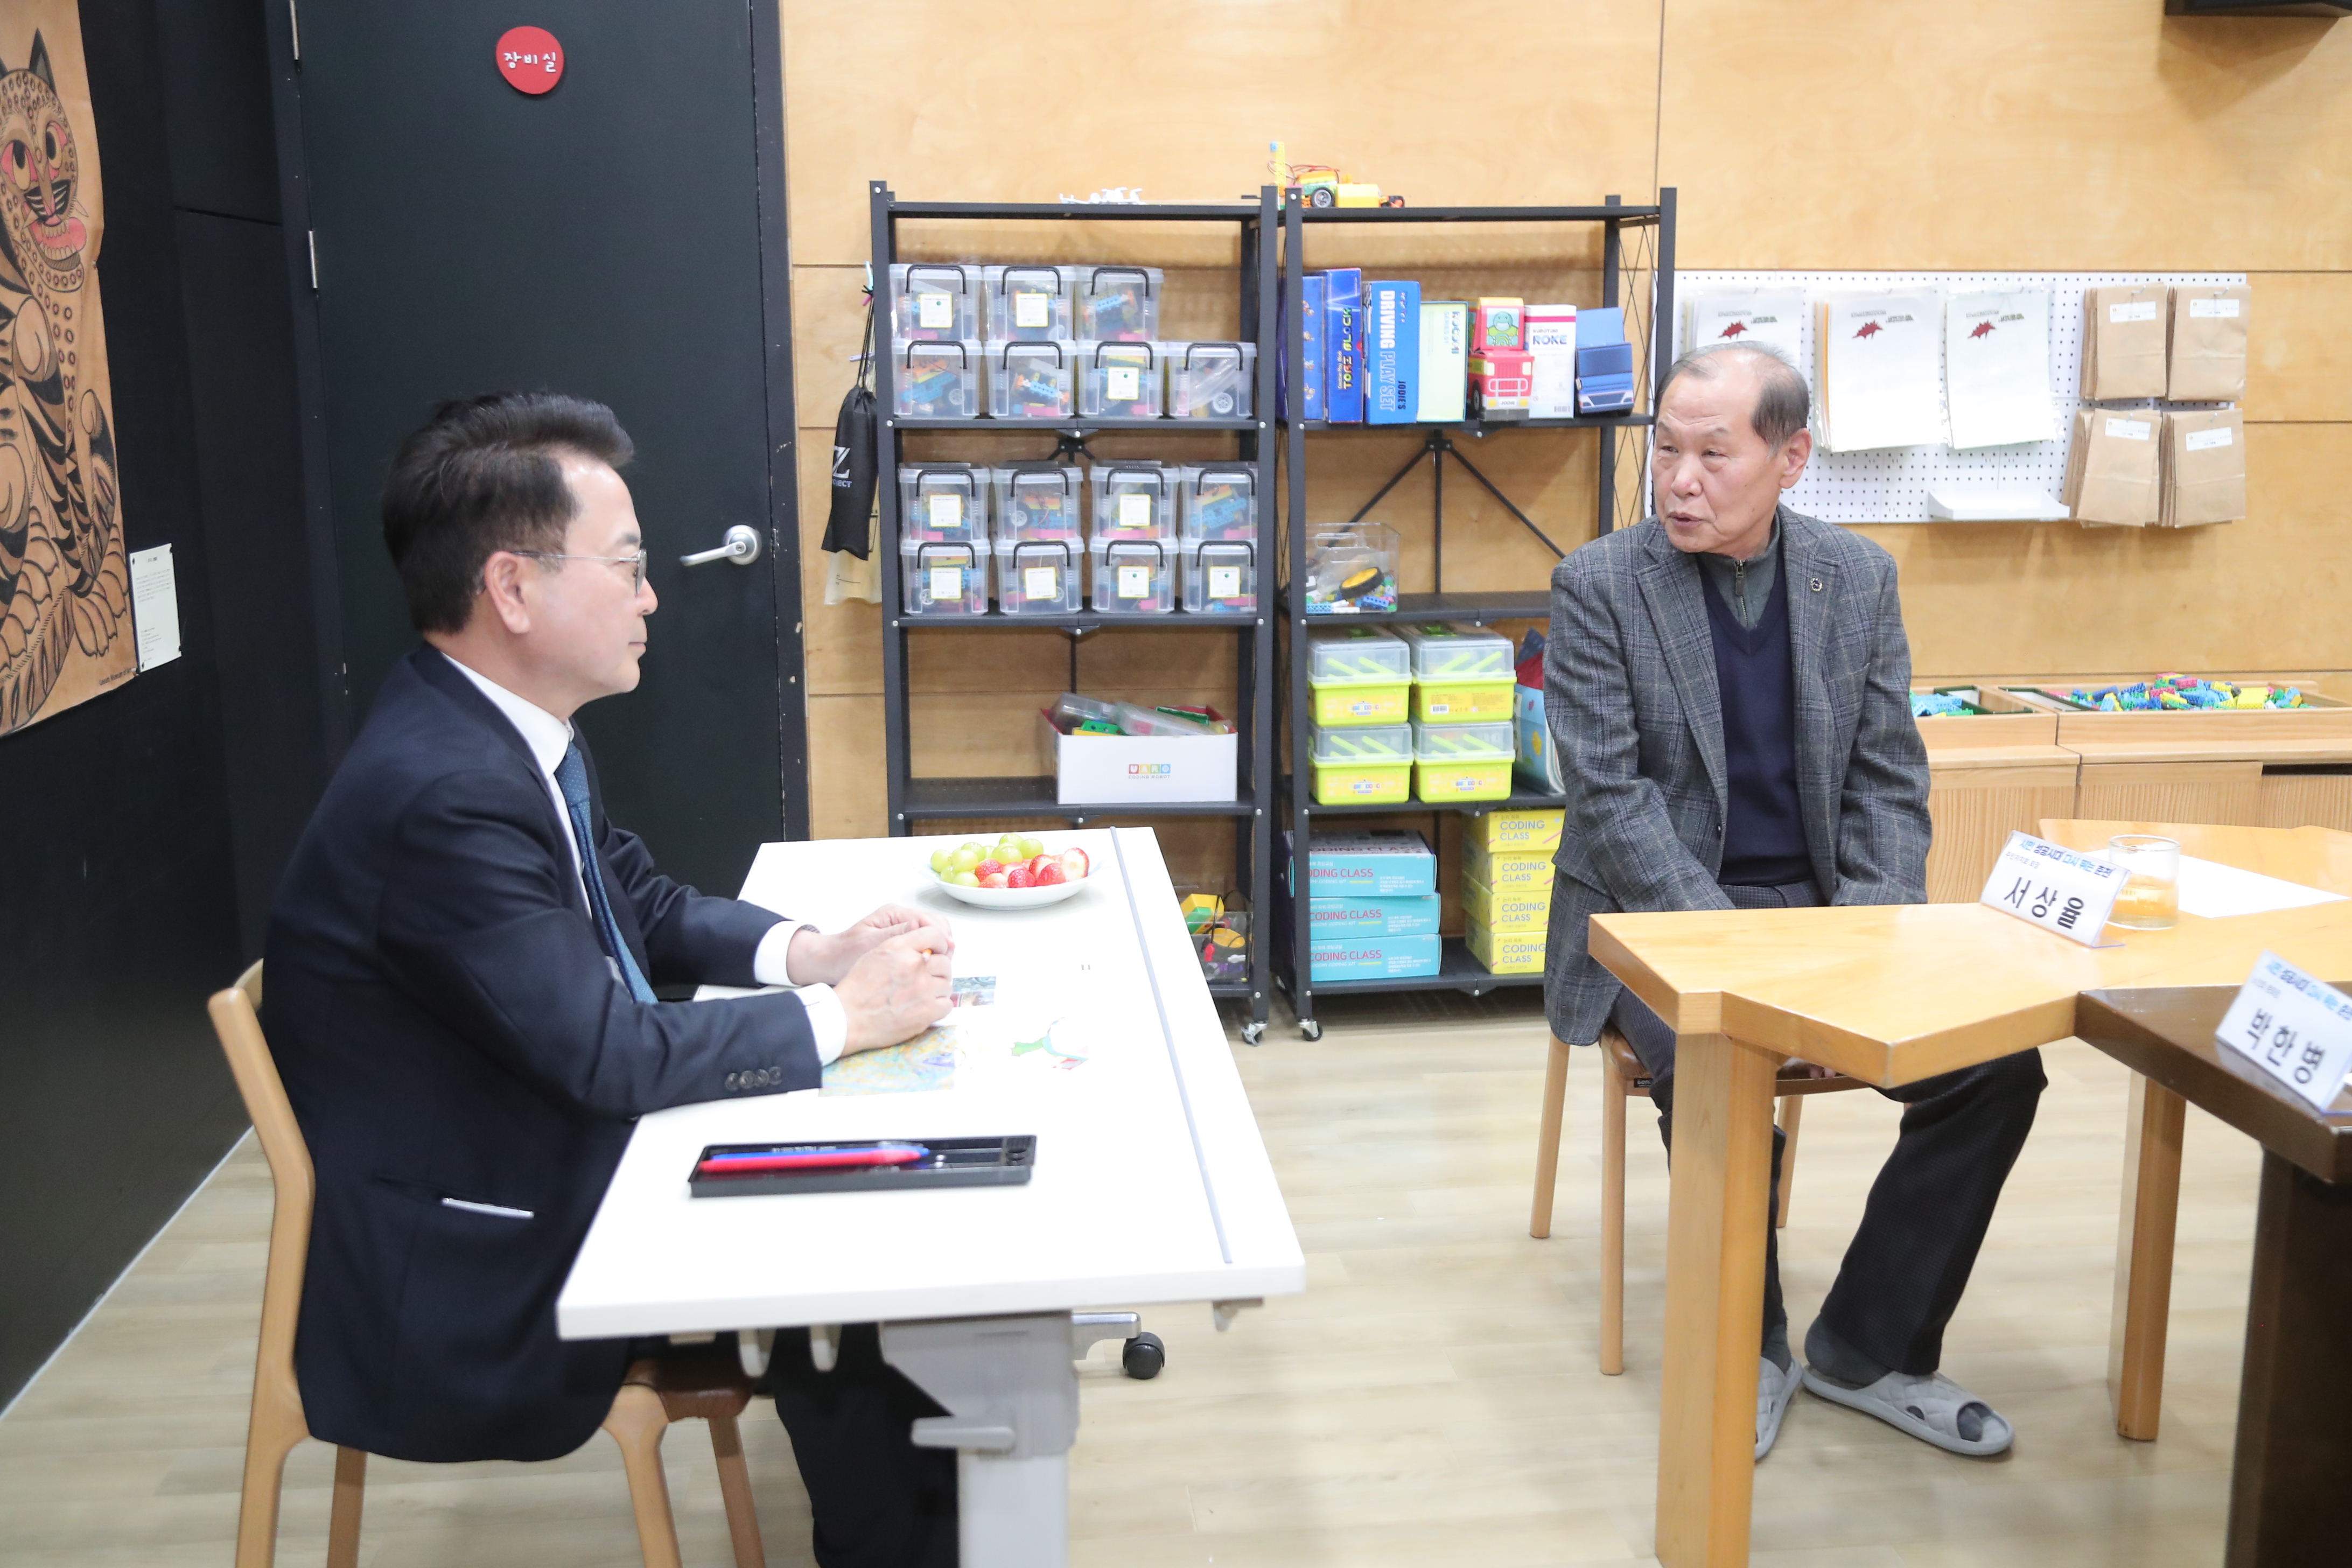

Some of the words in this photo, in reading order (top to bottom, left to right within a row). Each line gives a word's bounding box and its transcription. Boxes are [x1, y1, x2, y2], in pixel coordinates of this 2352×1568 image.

[503, 51, 556, 72] 장비실
[1380, 290, 1395, 349] DRIVING
[1343, 308, 1353, 351] BLOCK
[1533, 334, 1567, 345] ROKE
[1380, 351, 1395, 383] PLAY
[1380, 385, 1395, 411] SET
[1398, 381, 1406, 410] JODIE'S
[1130, 765, 1170, 773] UARO
[1500, 820, 1545, 830] CODING
[1500, 832, 1529, 840] CLASS
[2062, 854, 2080, 866] 다시
[1502, 862, 1546, 871] CODING
[1340, 869, 1374, 877] CLASS
[1502, 873, 1531, 881] CLASS
[1502, 902, 1546, 912] CODING
[1310, 911, 1347, 921] CODING
[1349, 909, 1382, 919] CLASS
[1502, 914, 1530, 922] CLASS
[1503, 943, 1546, 953] CODING
[1311, 951, 1347, 962] CODING
[1349, 949, 1382, 960] CLASS
[1502, 955, 1531, 963] CLASS
